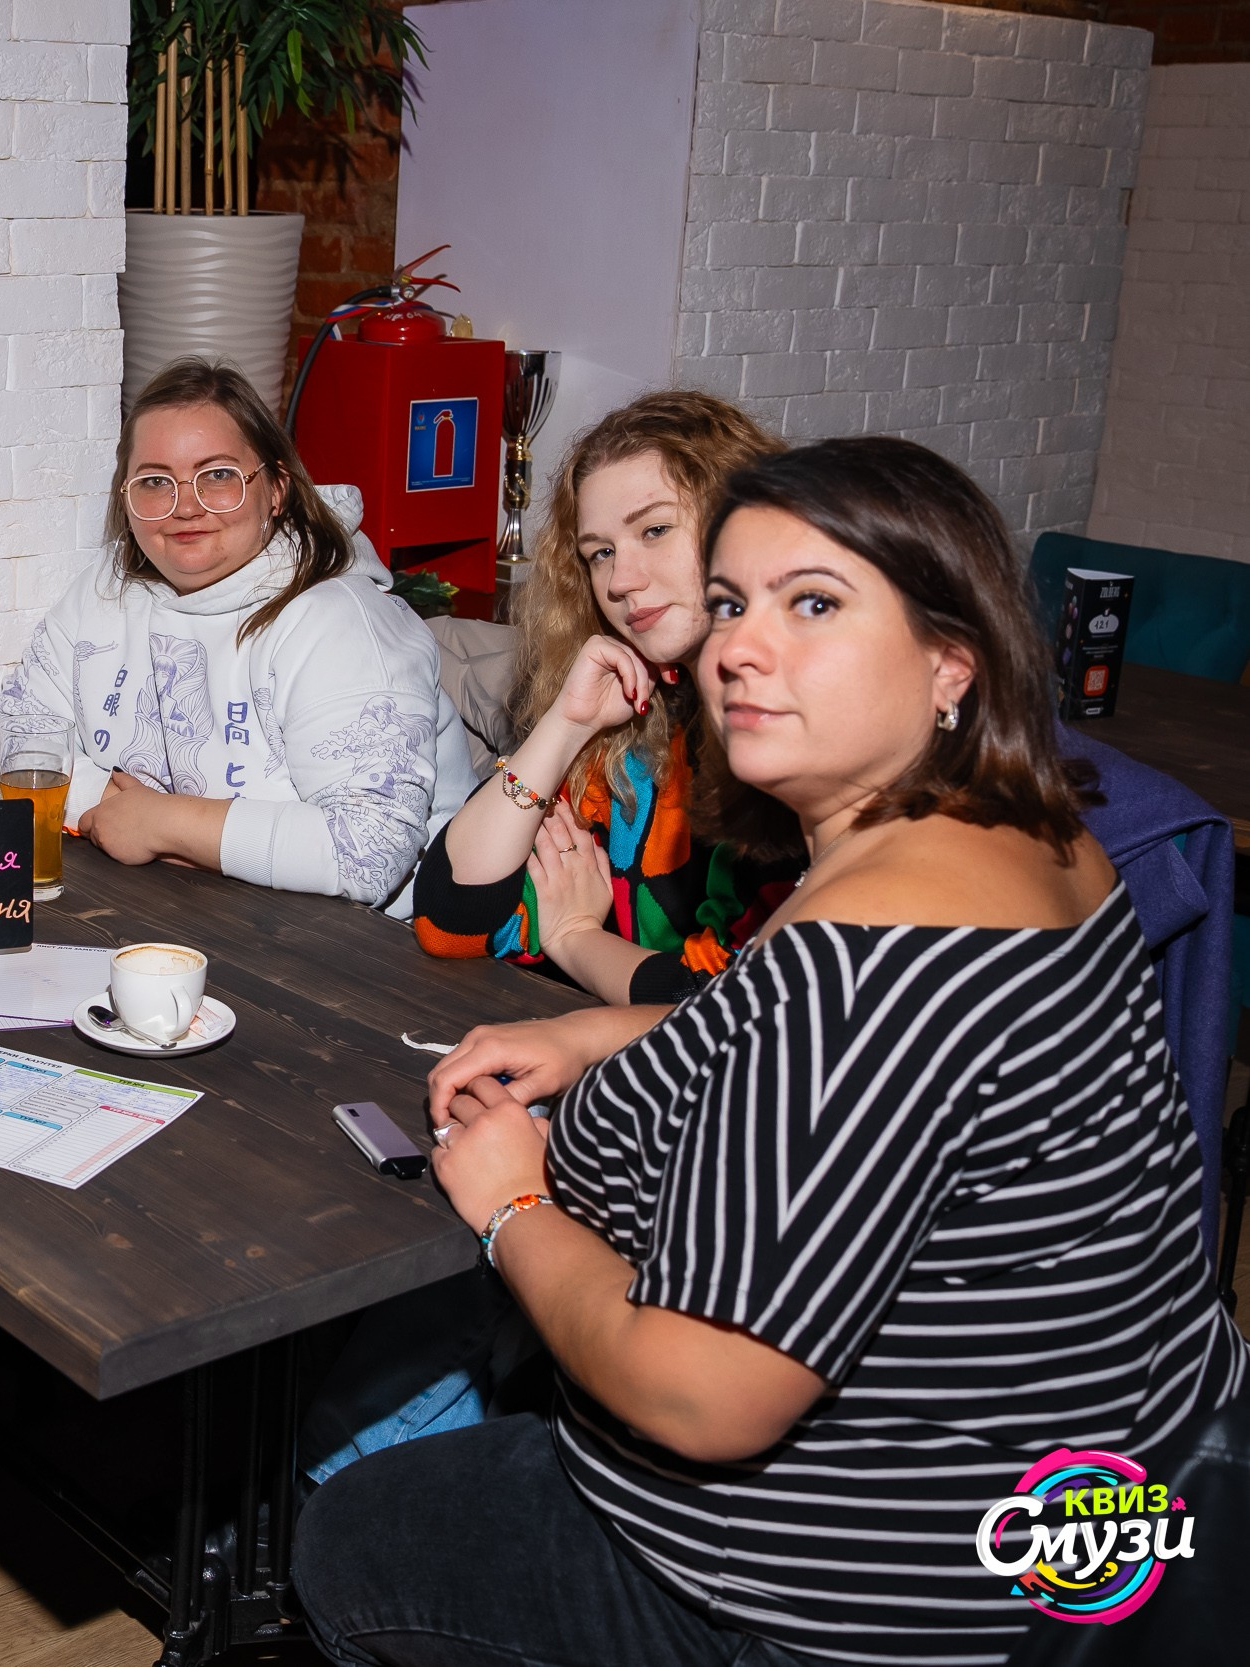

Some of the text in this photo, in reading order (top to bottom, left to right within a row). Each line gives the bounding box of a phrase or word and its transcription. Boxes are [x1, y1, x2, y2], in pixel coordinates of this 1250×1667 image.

[224, 701, 250, 800] 日向ヒ
[25, 1057, 63, 1069] КАУНТЕР
